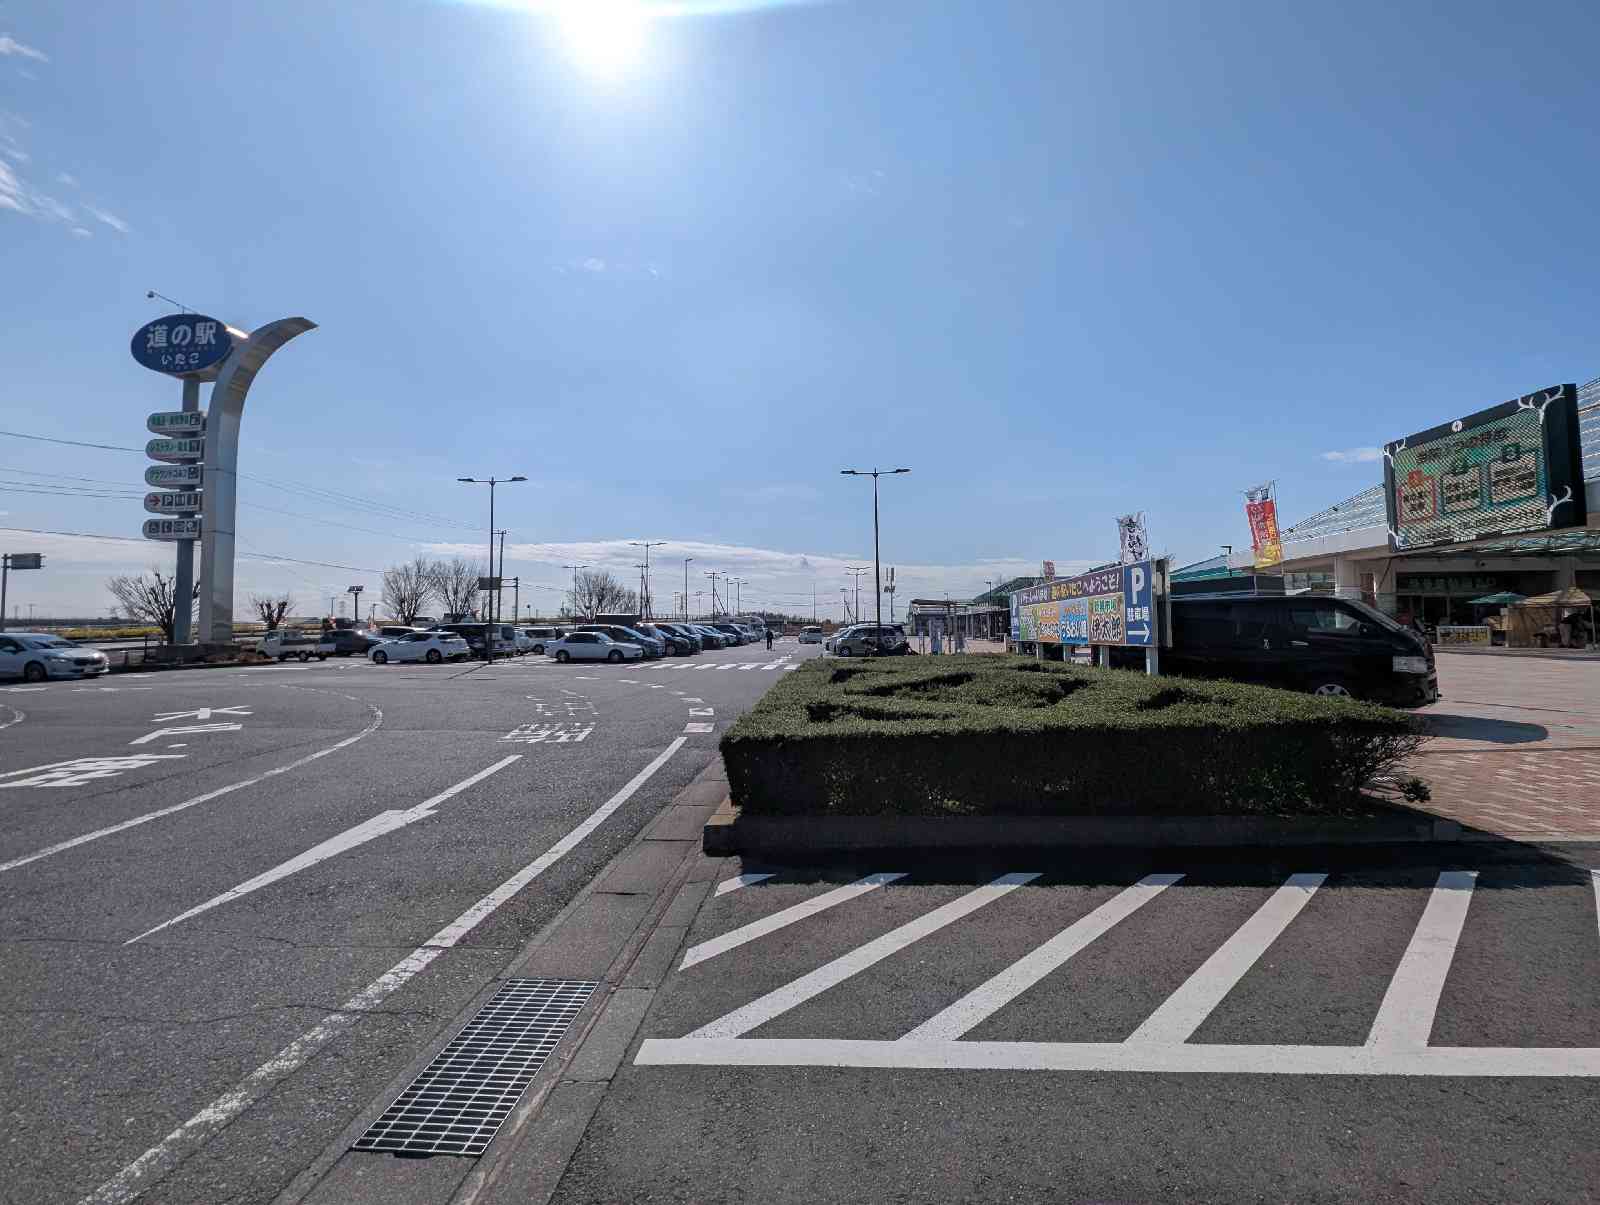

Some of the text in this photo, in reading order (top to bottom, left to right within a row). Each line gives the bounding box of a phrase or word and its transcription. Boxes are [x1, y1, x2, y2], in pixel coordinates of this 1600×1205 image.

[146, 322, 217, 348] 道の駅
[160, 352, 200, 365] いたこ
[1131, 567, 1145, 604] P
[1127, 606, 1150, 622] 駐車場
